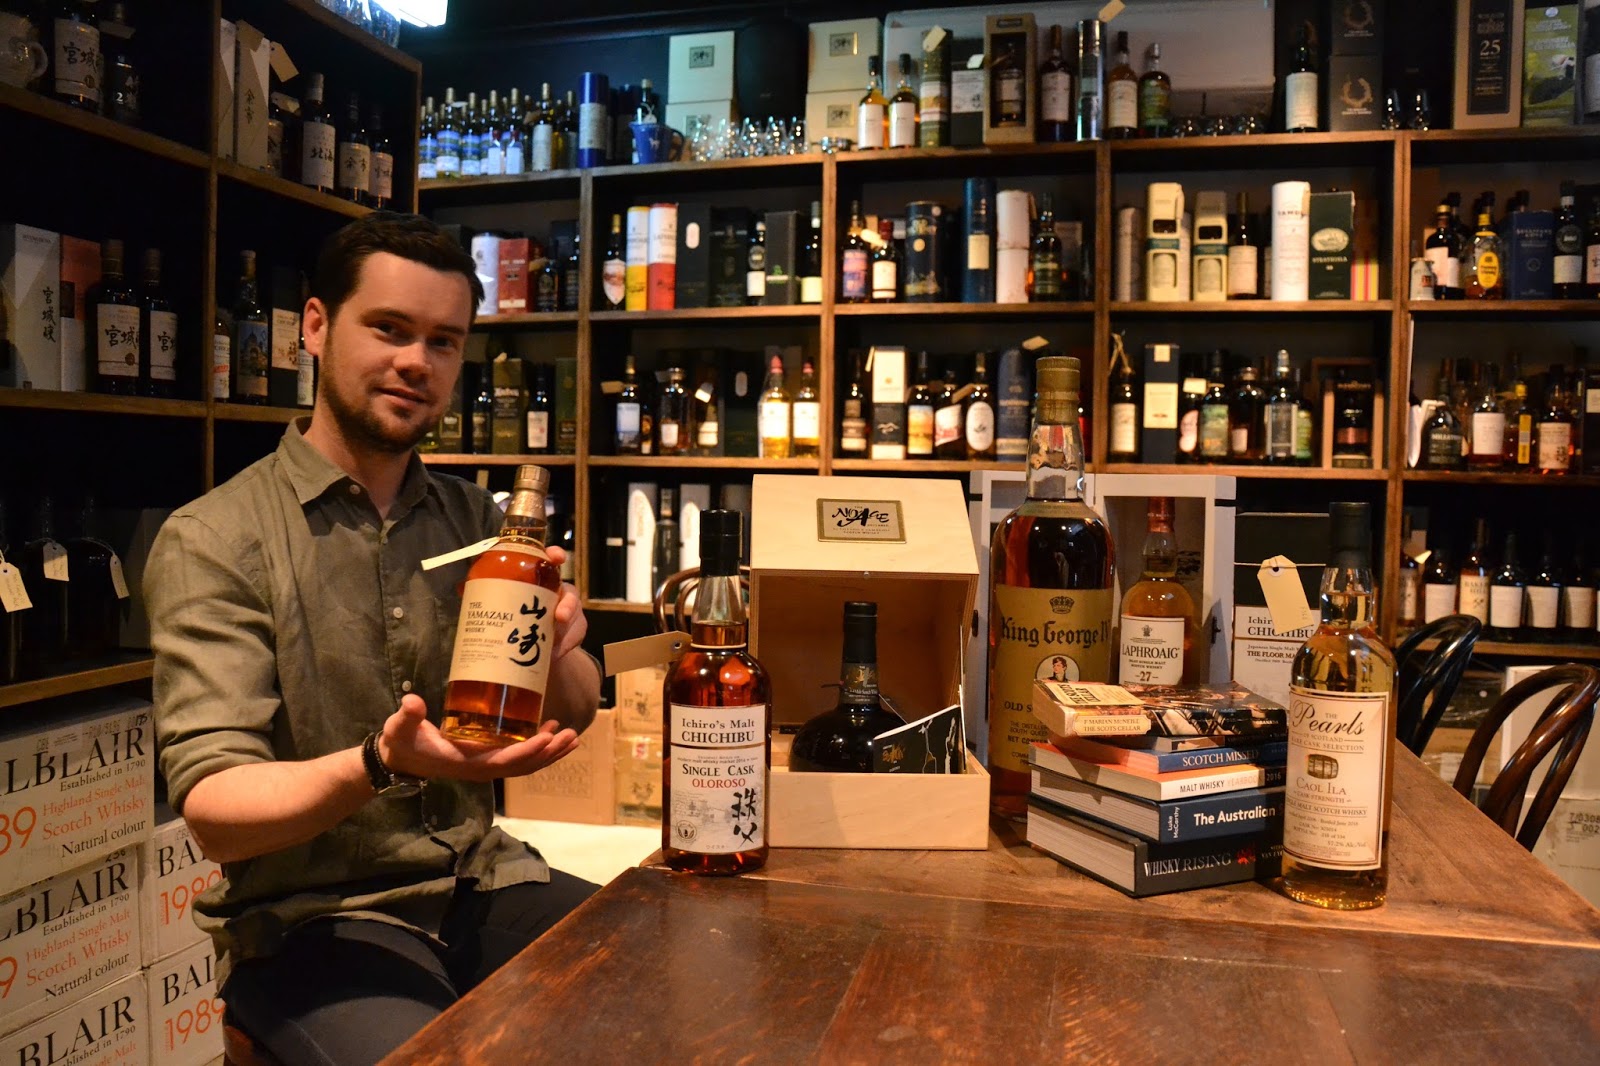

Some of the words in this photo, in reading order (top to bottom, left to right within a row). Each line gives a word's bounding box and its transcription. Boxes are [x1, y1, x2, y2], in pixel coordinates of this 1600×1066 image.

[1480, 39, 1501, 56] 25
[469, 601, 482, 609] THE
[467, 610, 514, 621] YAMAZAKI
[487, 620, 505, 628] MALT
[1247, 616, 1273, 625] Ichir
[1000, 616, 1040, 648] King
[1043, 620, 1100, 649] George
[1122, 643, 1179, 659] LAPHROAIG
[1140, 670, 1152, 682] 27
[1004, 700, 1024, 712] OLD
[682, 718, 725, 729] Ichiro's
[730, 719, 755, 729] Malt
[1292, 700, 1365, 735] Pearls
[681, 731, 755, 744] CHICHIBU
[1007, 735, 1019, 743] NET
[1304, 740, 1321, 748] CASK
[1323, 742, 1365, 751] SELECTION
[1311, 733, 1344, 743] SCOTLAND
[0, 726, 145, 797] LBLAIR
[1012, 751, 1029, 759] COMM
[1182, 751, 1224, 767] SCOTCH
[1226, 750, 1259, 763] MISSED
[60, 768, 112, 792] Established
[114, 768, 123, 776] in
[126, 759, 146, 772] 1790
[682, 763, 721, 777] SINGLE
[728, 764, 755, 776] CASK
[692, 777, 746, 789] OLOROSO
[1179, 783, 1198, 793] MALT
[1199, 780, 1225, 791] WHISKY
[1296, 776, 1323, 793] CAOL
[1327, 782, 1347, 795] ILA
[42, 794, 92, 817] Highland
[94, 783, 122, 803] Single
[124, 775, 147, 791] Malt
[1311, 794, 1345, 803] STRENGTH
[1193, 812, 1215, 826] The
[1217, 805, 1276, 824] Australian
[1298, 802, 1312, 810] MALT
[1313, 805, 1340, 815] SCOTCH
[42, 814, 93, 841] Scotch
[96, 796, 147, 822] Whisky
[1173, 806, 1181, 839] McCarthy
[61, 829, 109, 859] Natural
[111, 819, 147, 840] colour
[157, 838, 207, 878] BA
[1143, 857, 1181, 877] WHISKY
[1182, 852, 1232, 872] RISING
[42, 910, 96, 937] Established
[98, 904, 107, 914] in
[110, 894, 130, 909] 1790
[26, 934, 76, 964] Highland
[78, 920, 108, 942] Single
[110, 910, 131, 929] Malt
[26, 954, 77, 988] Scotch
[81, 929, 132, 960] Whisky
[44, 970, 92, 1002] Natural
[95, 953, 130, 978] colour
[16, 994, 136, 1066] BLAIR
[164, 998, 227, 1051] 1989
[103, 1039, 112, 1048] in
[115, 1025, 136, 1041] 1790
